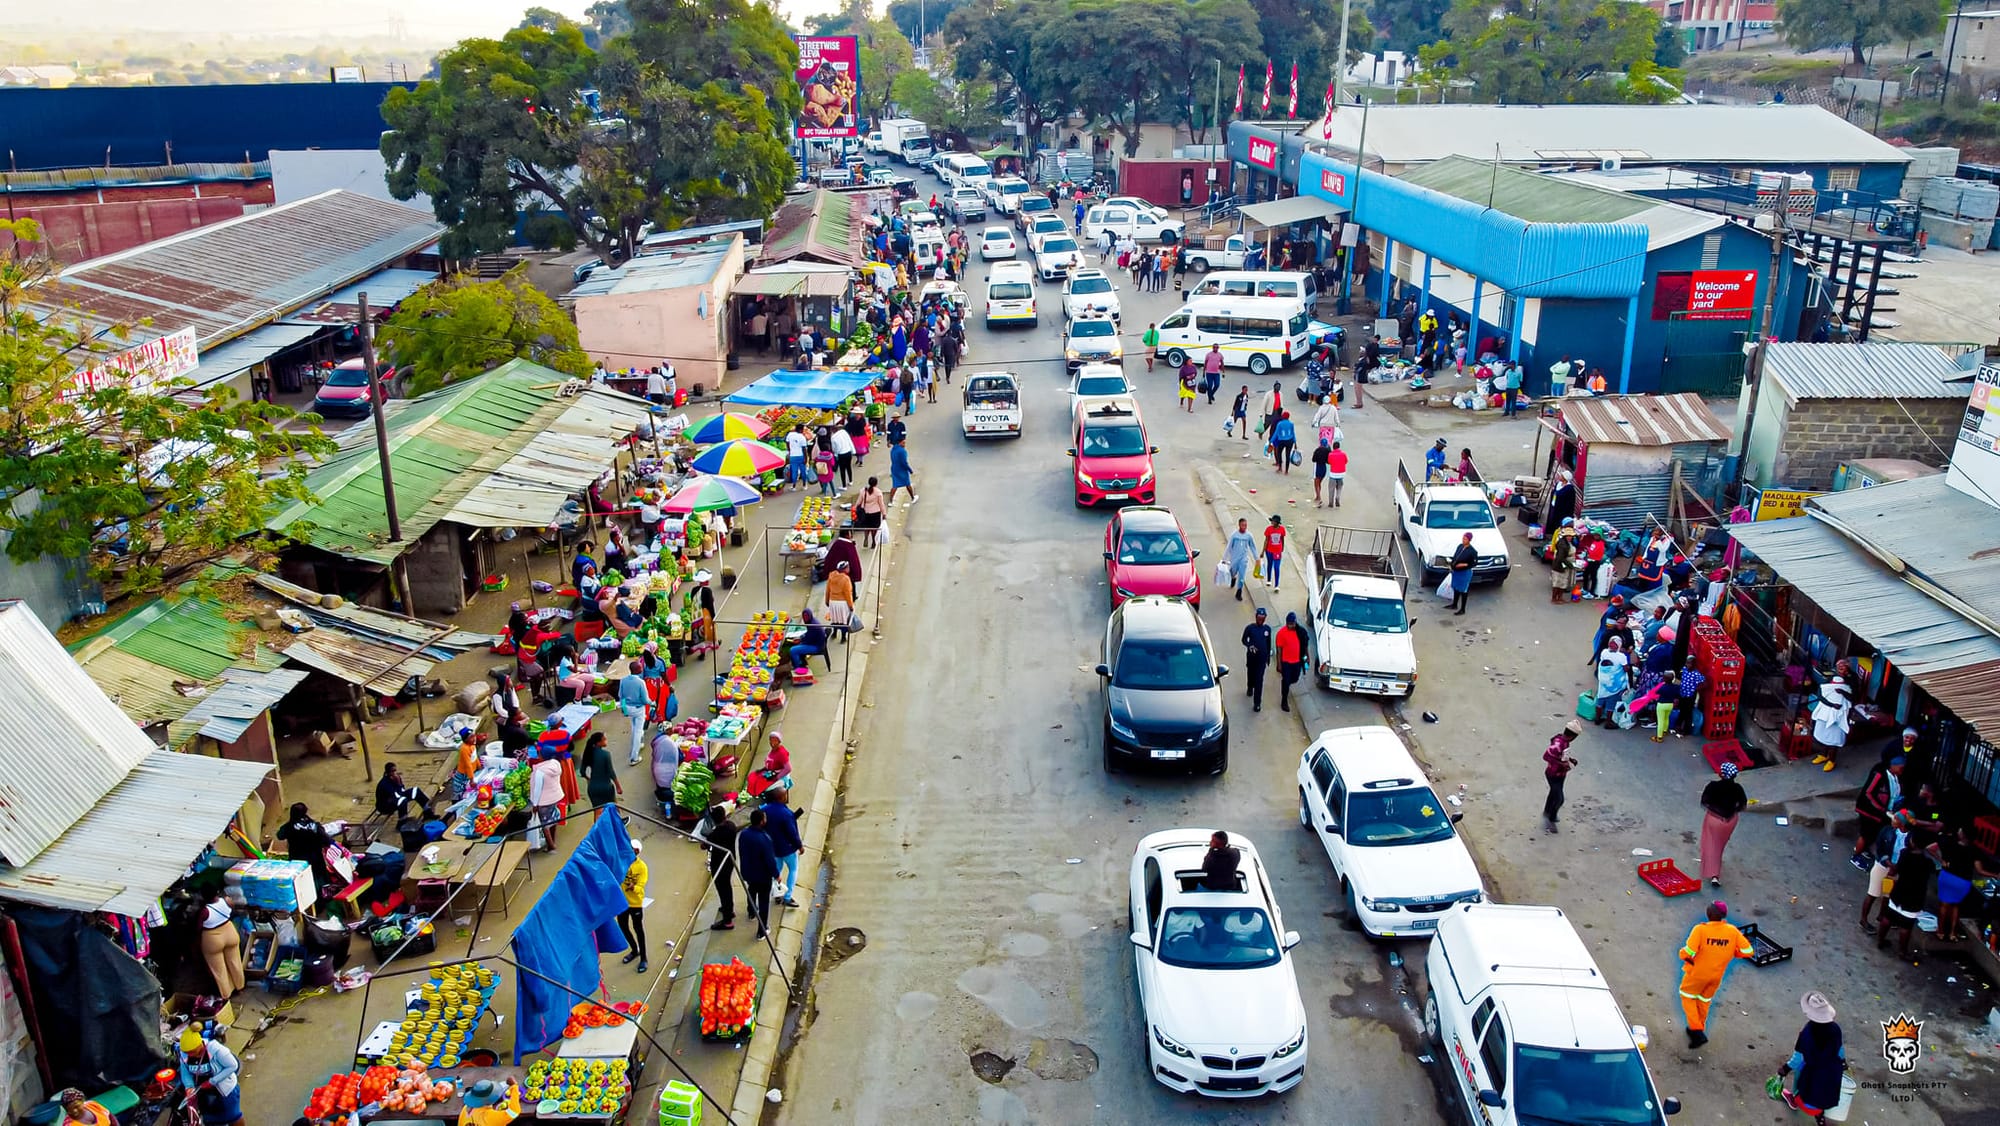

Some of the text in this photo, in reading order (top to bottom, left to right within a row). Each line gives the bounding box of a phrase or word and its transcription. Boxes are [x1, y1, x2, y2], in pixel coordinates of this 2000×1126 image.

[798, 42, 840, 50] STREETWISE
[1324, 174, 1341, 192] LIN'S
[1696, 282, 1740, 290] Welcome
[1692, 300, 1714, 310] yard
[1978, 366, 2000, 387] ESA
